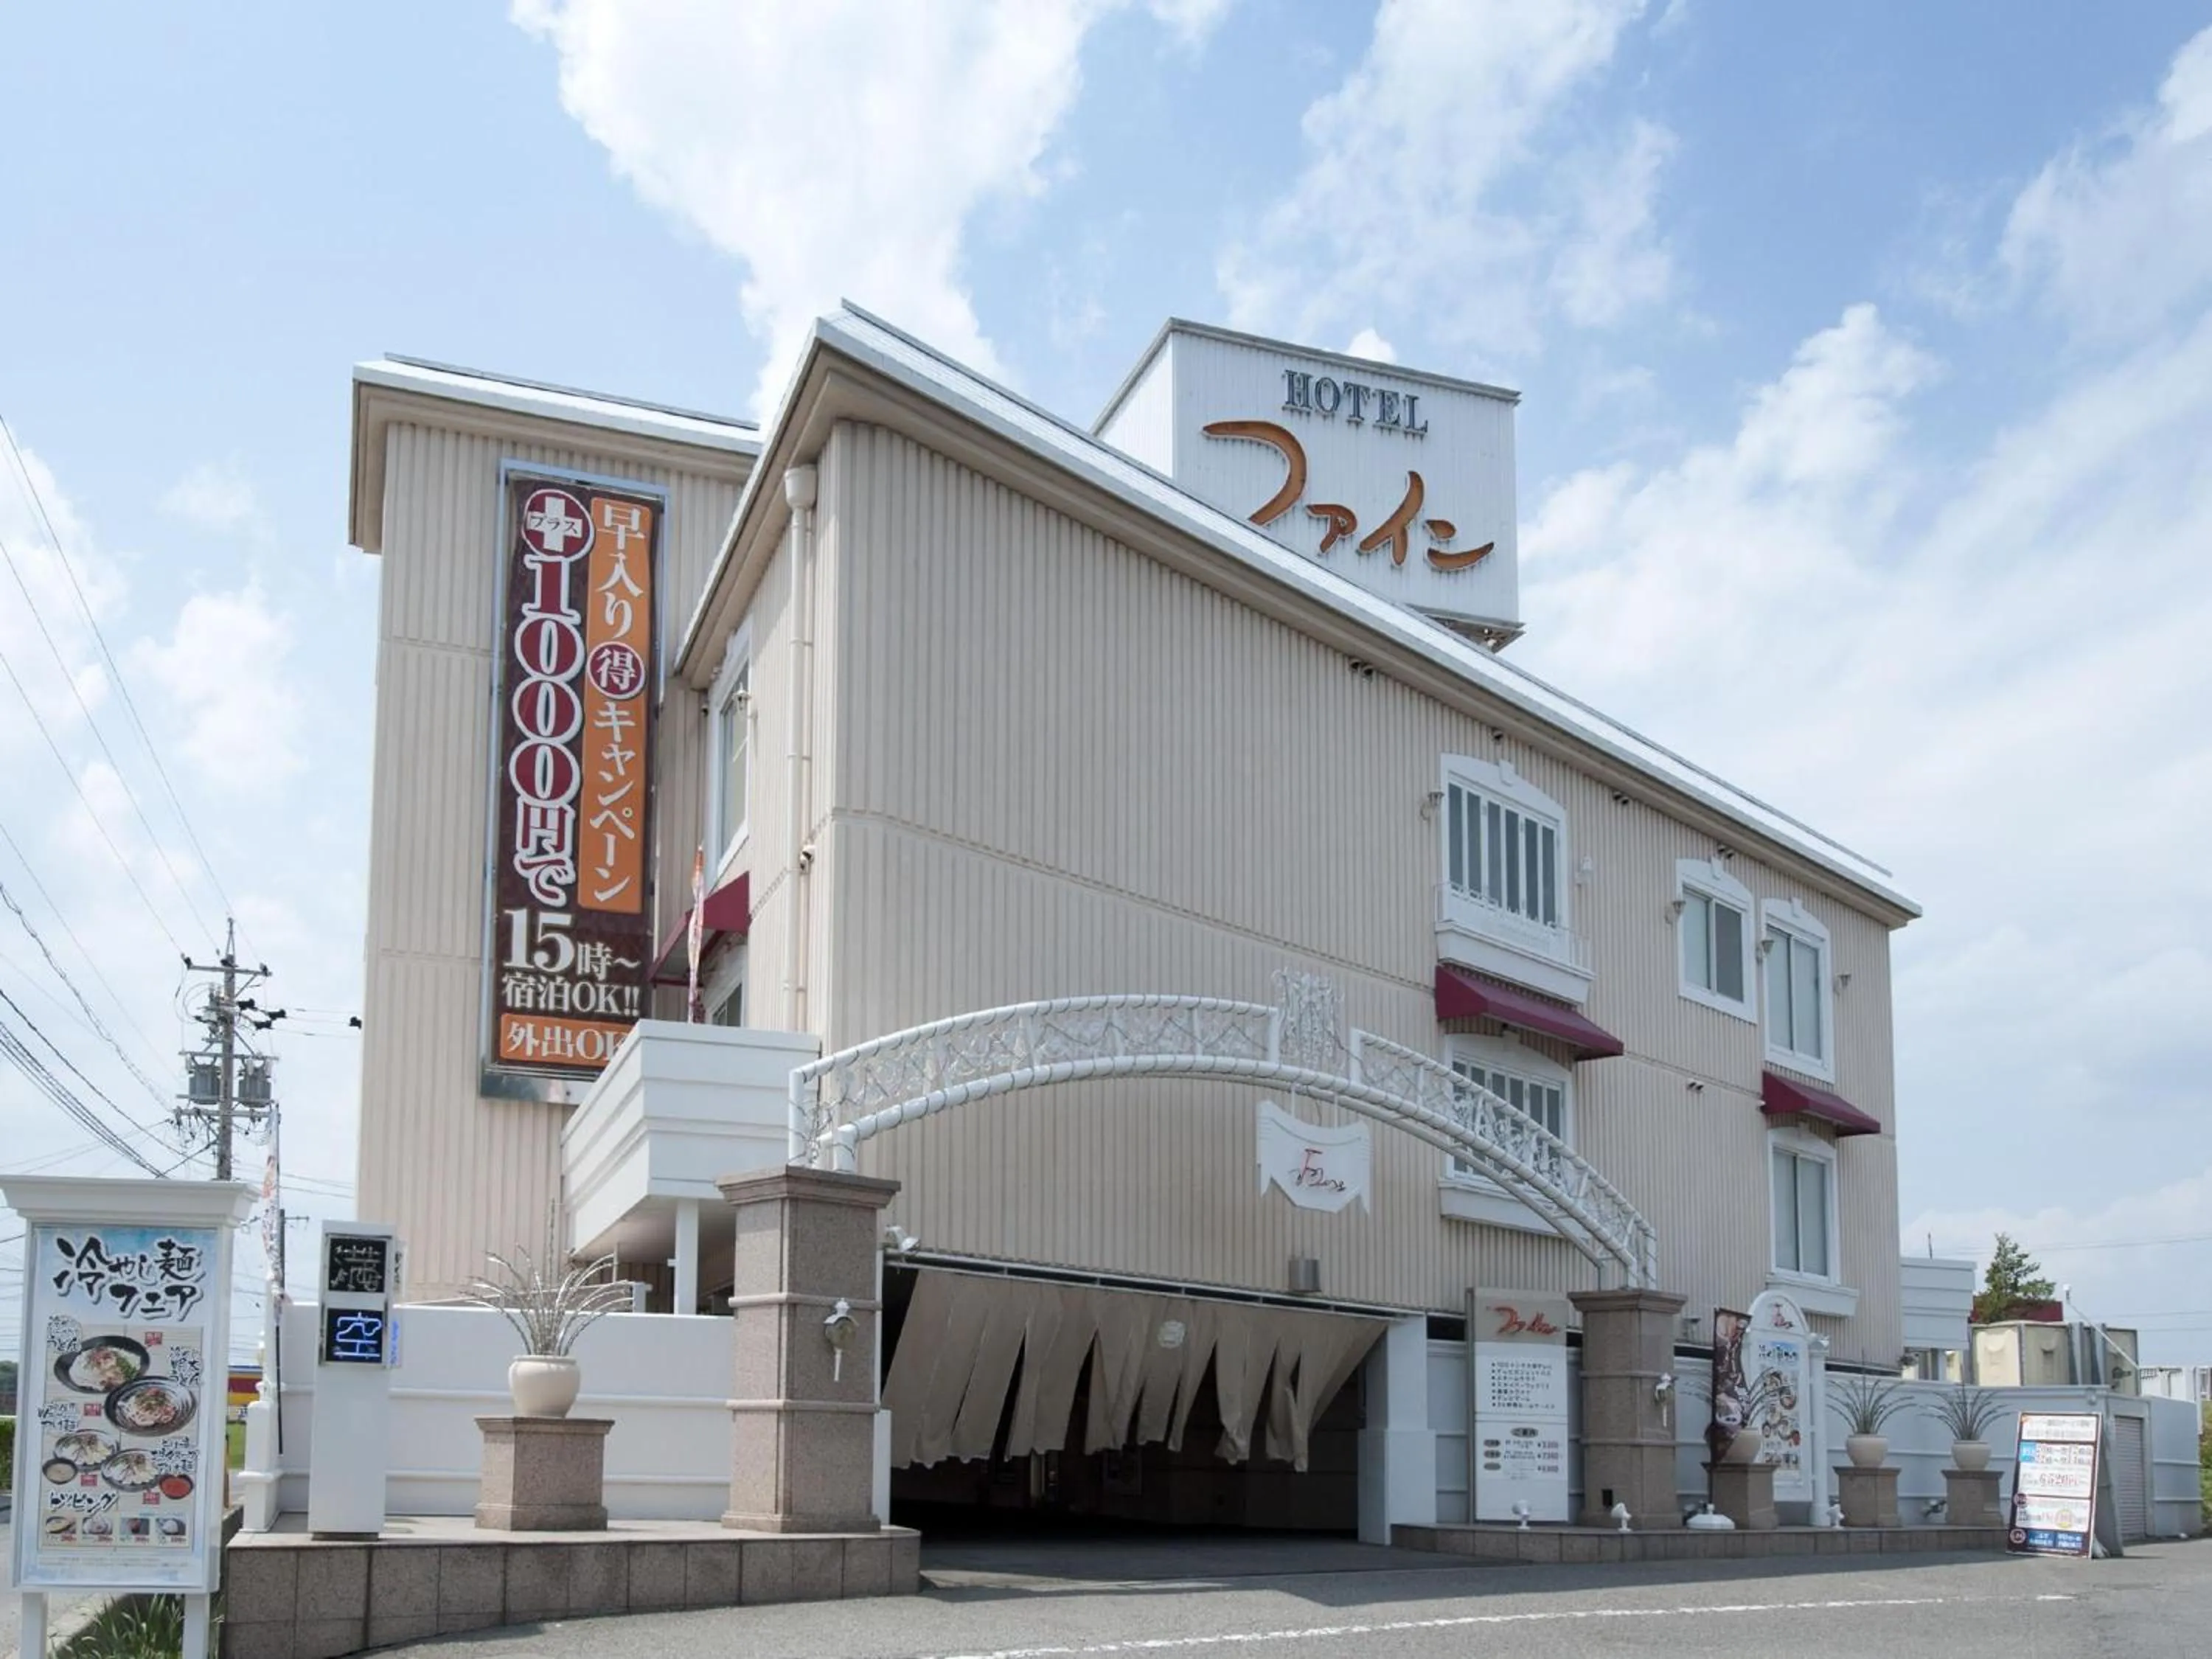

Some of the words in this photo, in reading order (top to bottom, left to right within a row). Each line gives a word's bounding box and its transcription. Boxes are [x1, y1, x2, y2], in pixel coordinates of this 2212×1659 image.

[1283, 369, 1428, 434] HOTEL
[529, 514, 580, 535] プラス
[1203, 421, 1495, 570] ファイン
